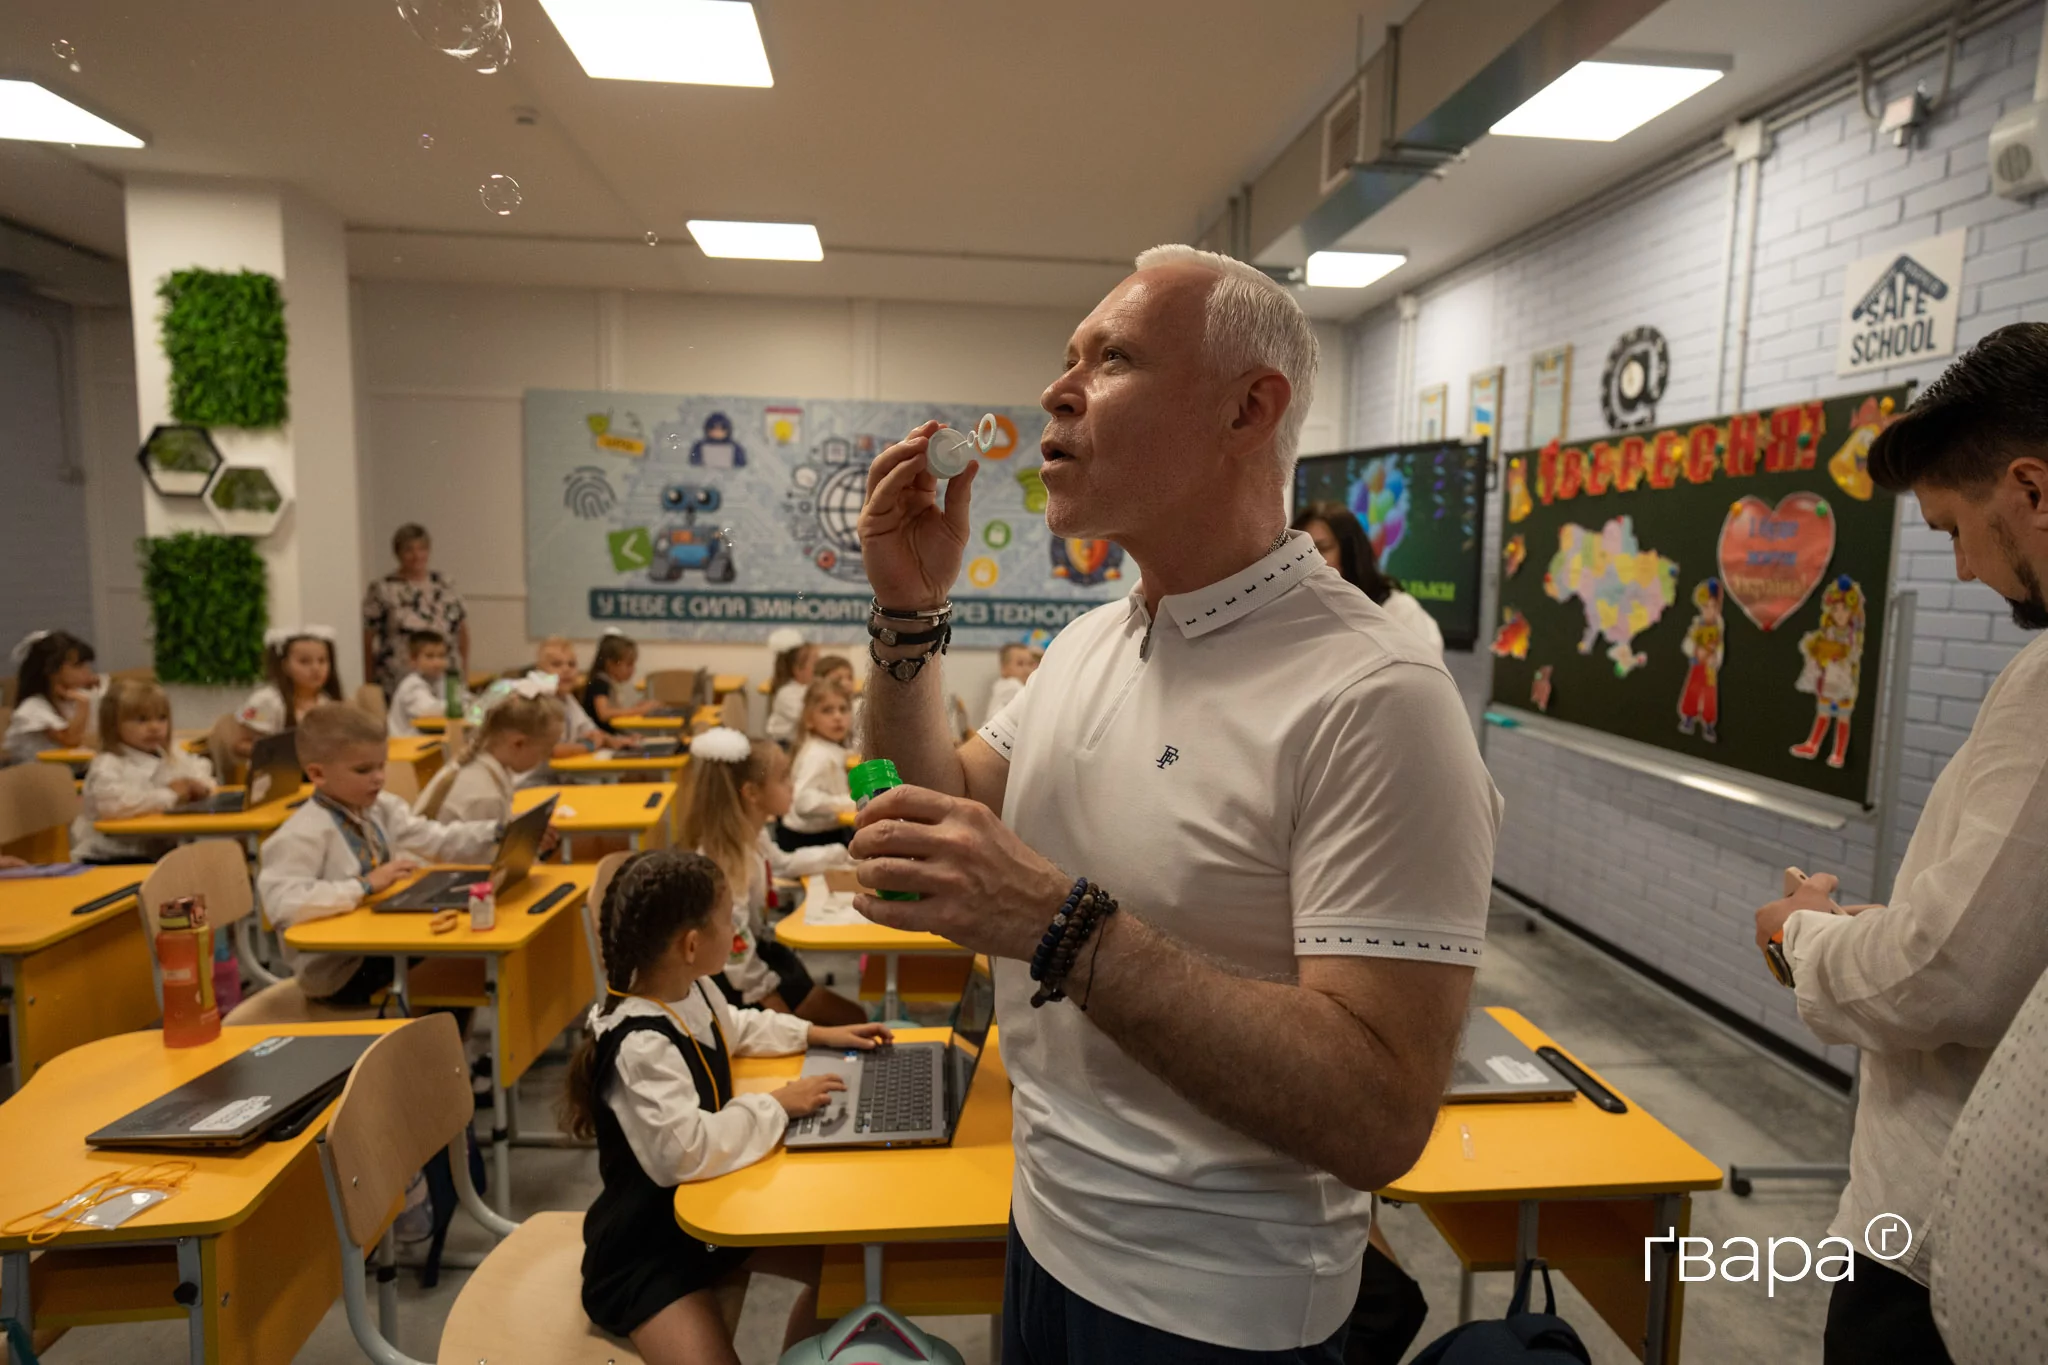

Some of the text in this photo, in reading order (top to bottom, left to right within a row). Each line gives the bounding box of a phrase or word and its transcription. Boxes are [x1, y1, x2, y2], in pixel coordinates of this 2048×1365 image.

[1865, 277, 1928, 327] SAFE
[1850, 317, 1936, 365] SCHOOL
[596, 594, 615, 616] У
[618, 594, 668, 617] ТЕБЕ
[688, 596, 748, 619] СИЛА
